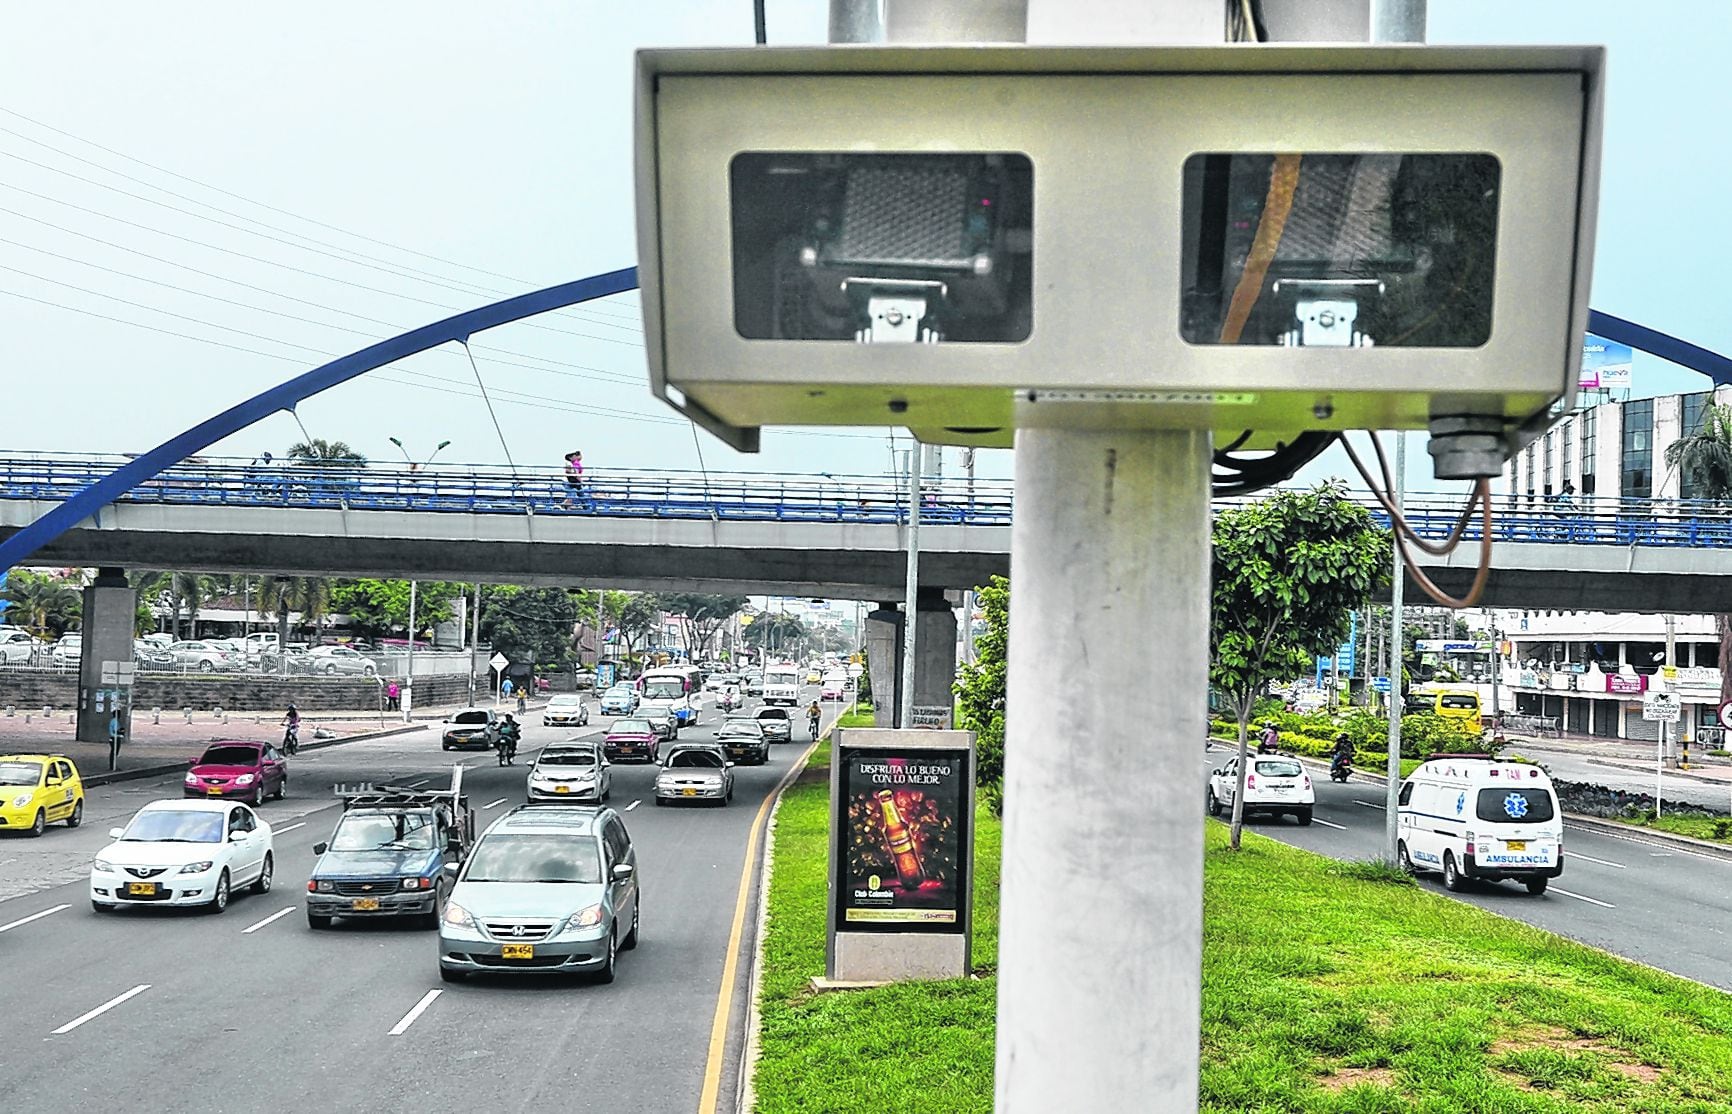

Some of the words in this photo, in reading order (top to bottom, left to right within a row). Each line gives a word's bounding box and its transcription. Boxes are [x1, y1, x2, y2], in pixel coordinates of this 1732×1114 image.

[860, 764, 903, 775] DISFRUTA
[905, 765, 917, 775] LO
[919, 766, 951, 776] BUENO
[872, 774, 892, 784] CON
[894, 775, 906, 784] LO
[1486, 855, 1549, 864] AMBULANCIA
